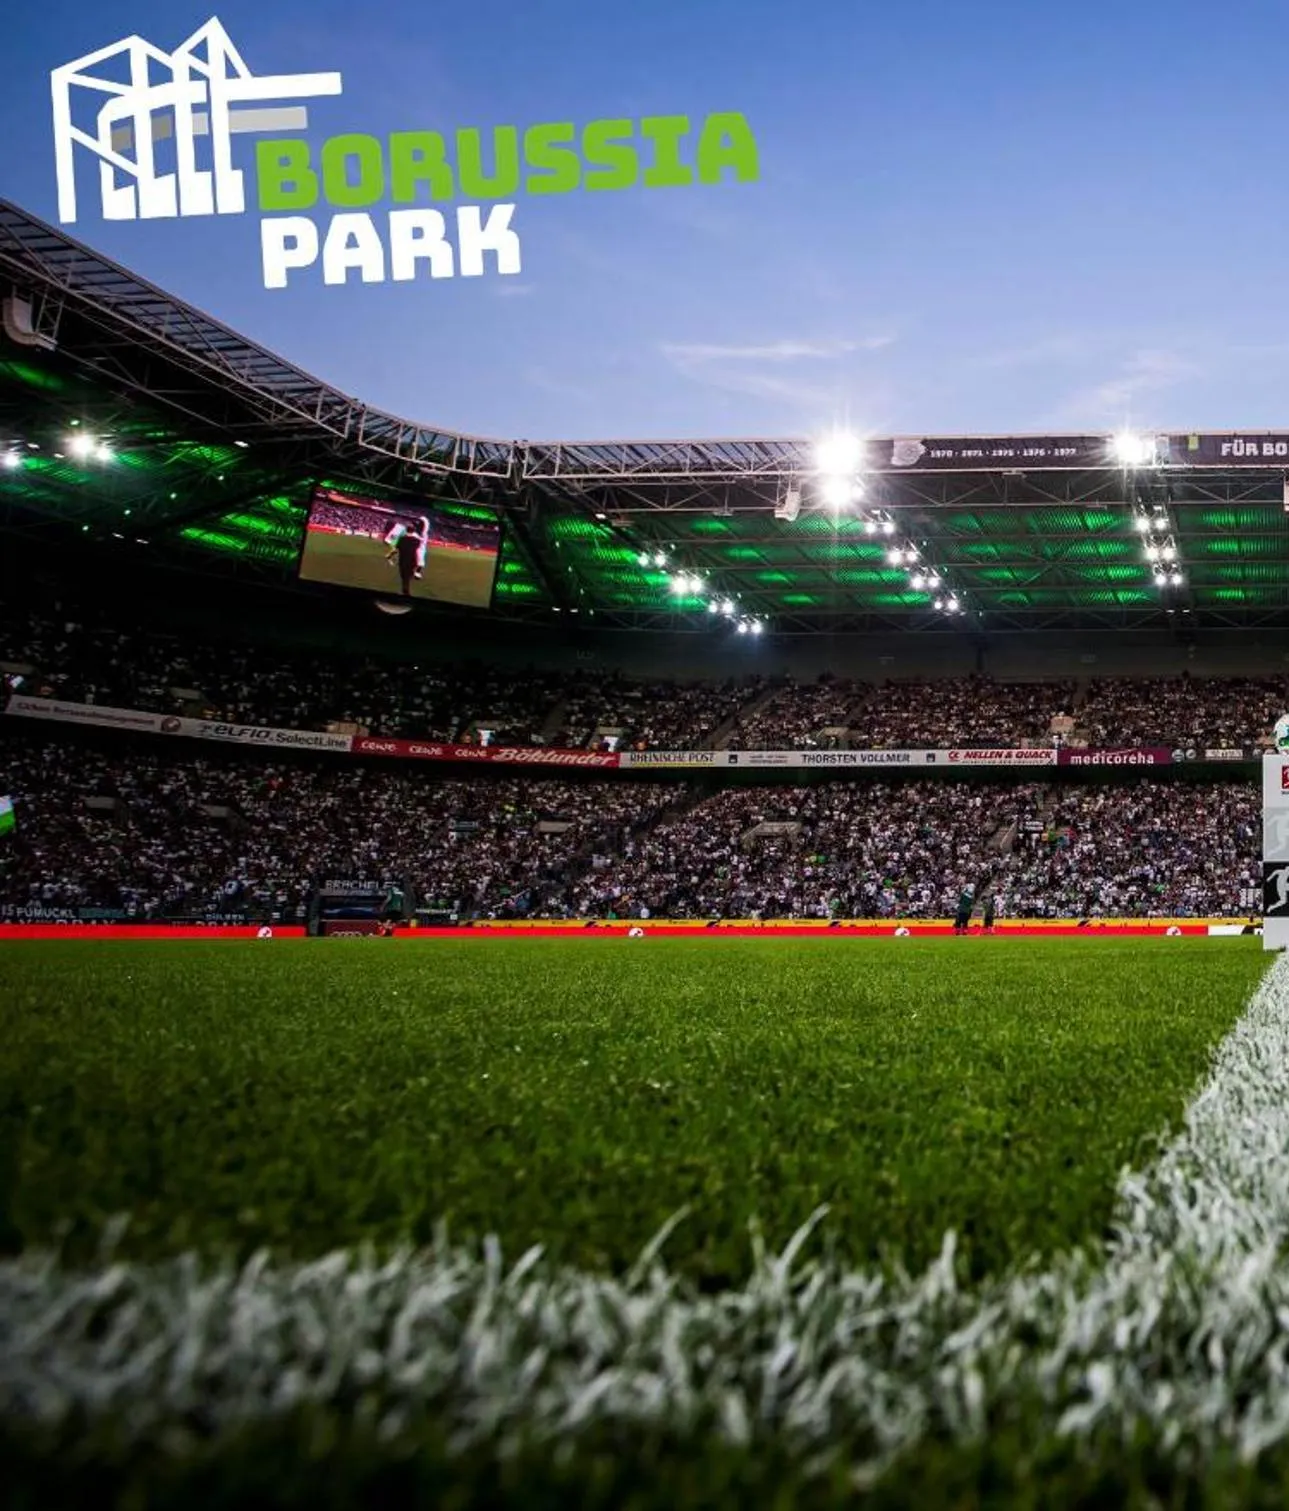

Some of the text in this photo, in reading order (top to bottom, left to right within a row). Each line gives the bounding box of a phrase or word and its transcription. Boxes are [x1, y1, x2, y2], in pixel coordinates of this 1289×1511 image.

[1220, 439, 1258, 457] FÜR
[492, 748, 618, 767] Böklunder
[802, 753, 911, 764] THORSTEN VOLLMER
[1070, 753, 1155, 765] medicoreha
